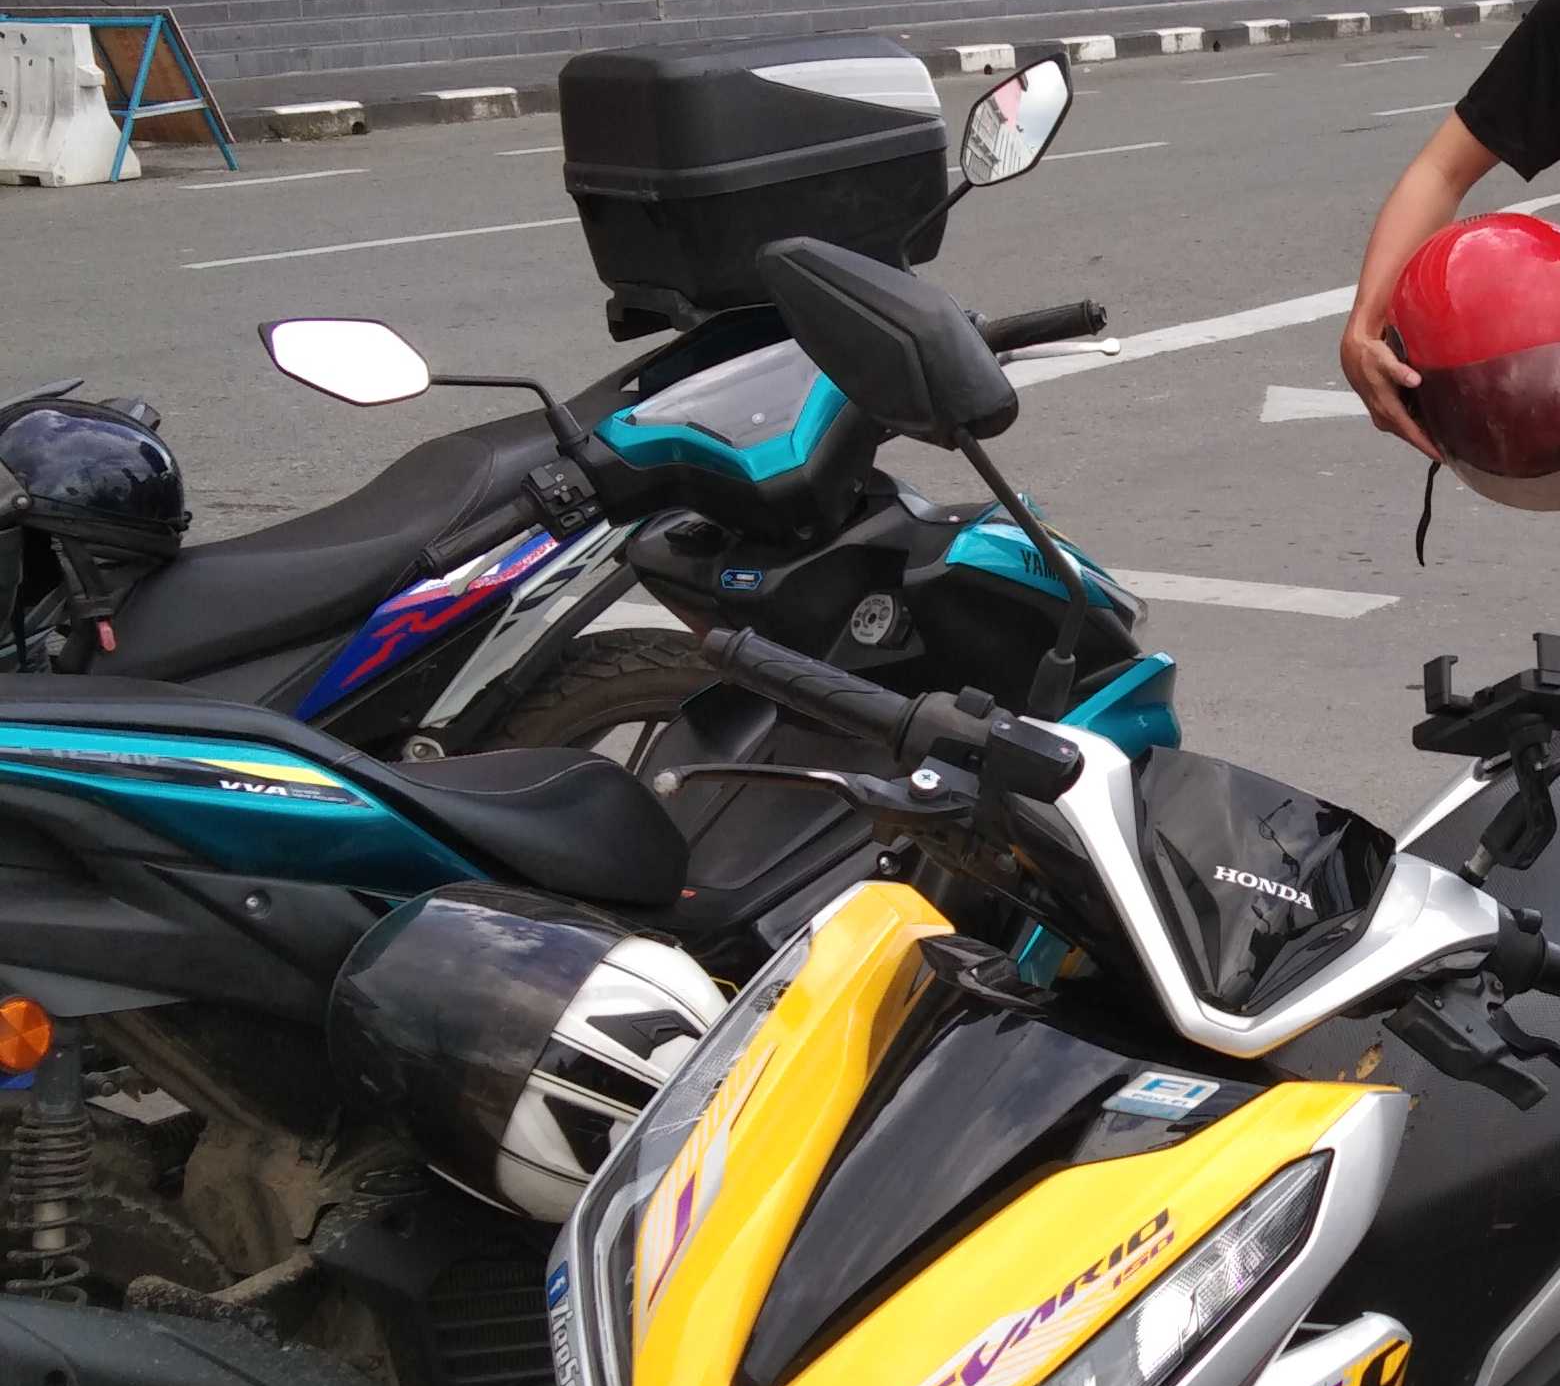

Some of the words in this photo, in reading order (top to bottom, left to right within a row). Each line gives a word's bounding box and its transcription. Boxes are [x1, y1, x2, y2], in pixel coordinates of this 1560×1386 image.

[1021, 548, 1061, 581] YAM
[219, 779, 289, 797] VVA
[1213, 865, 1314, 910] HONDA
